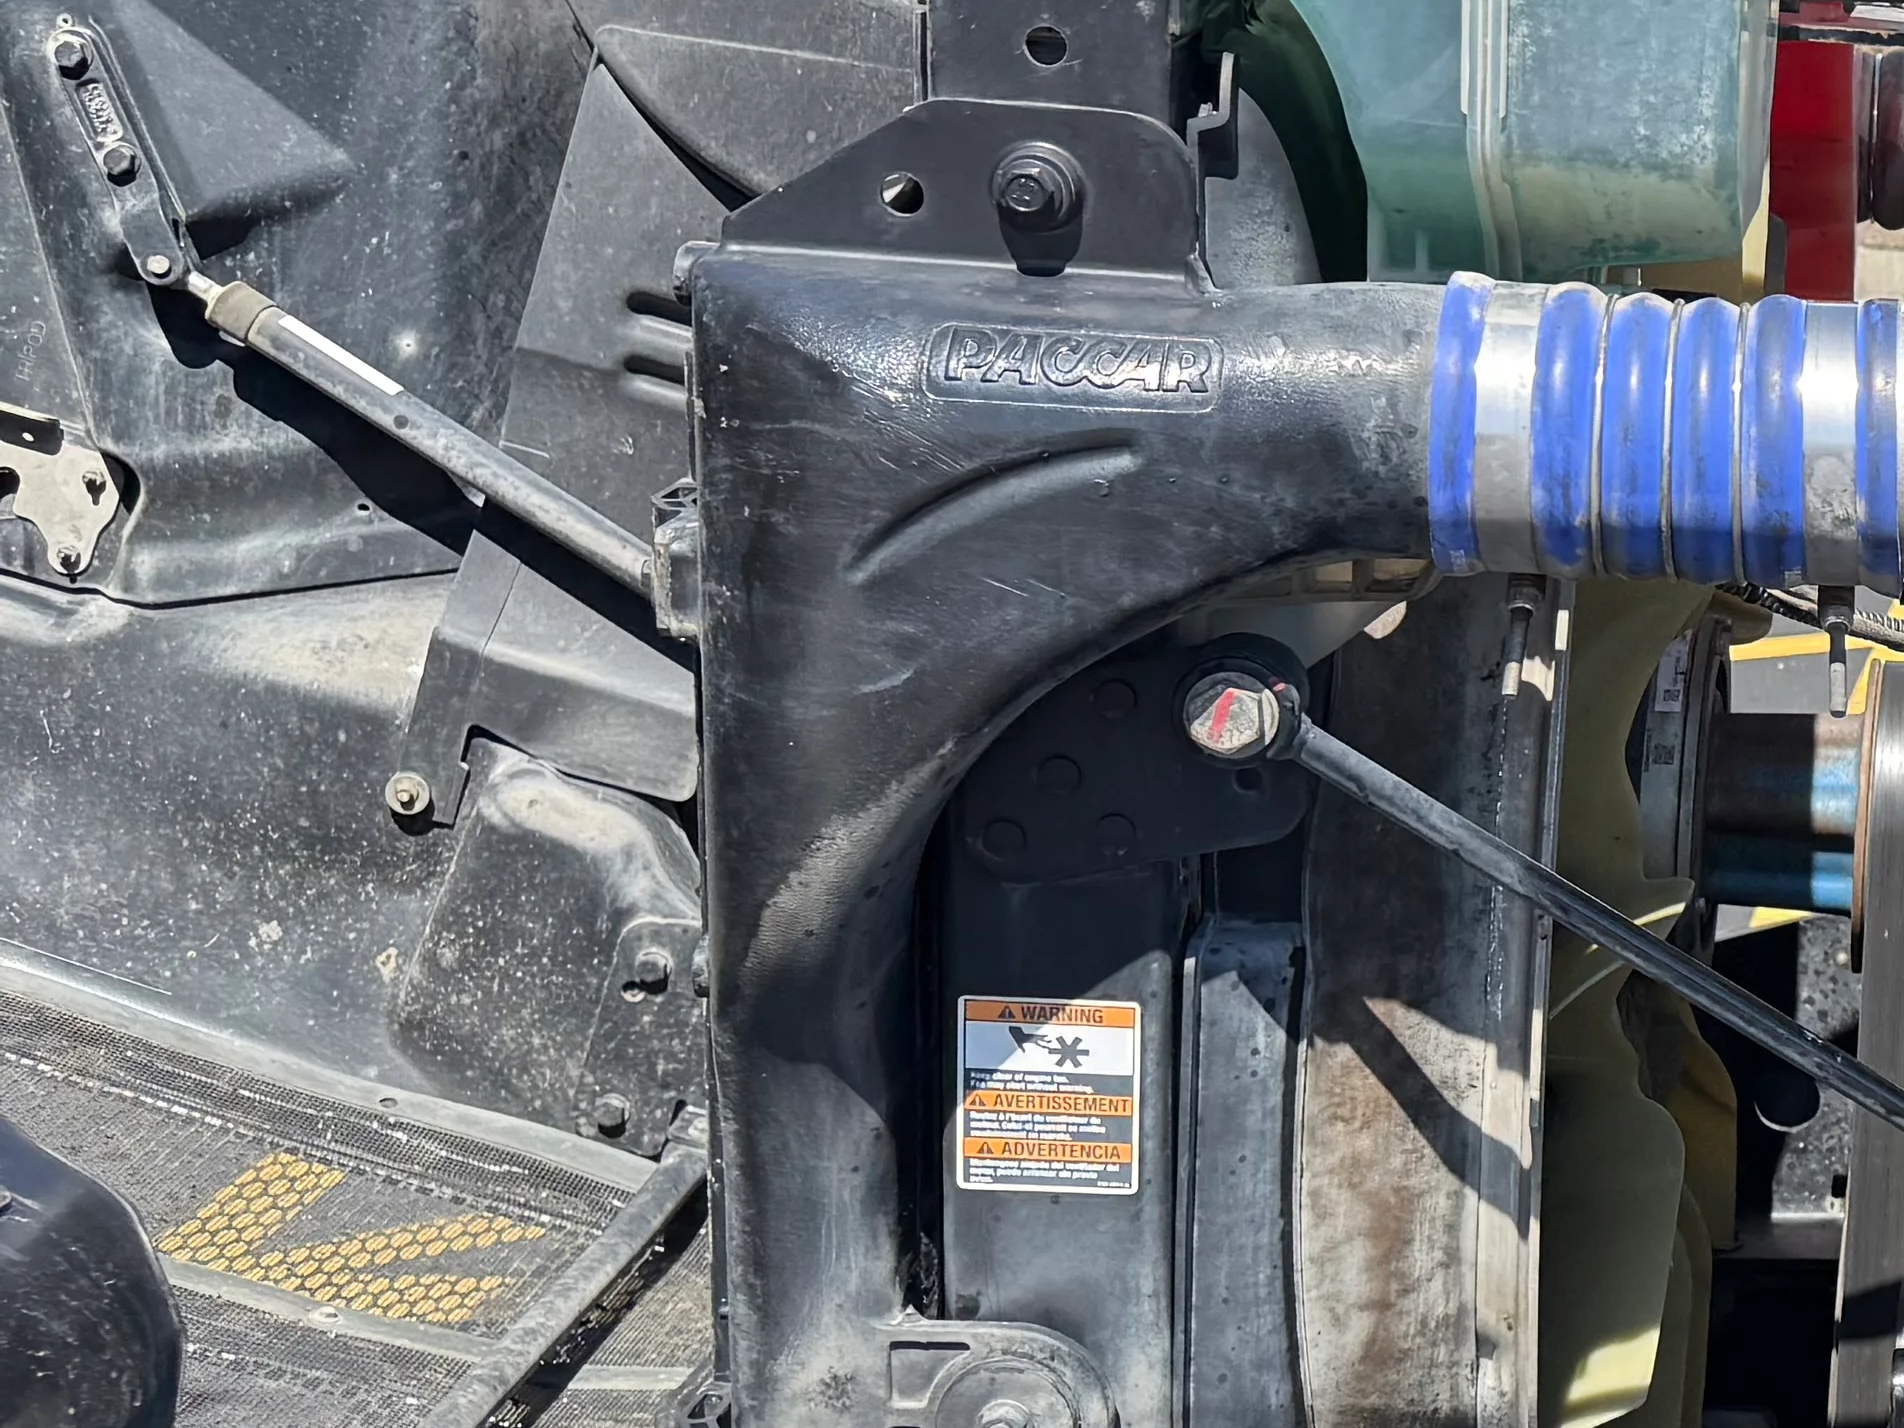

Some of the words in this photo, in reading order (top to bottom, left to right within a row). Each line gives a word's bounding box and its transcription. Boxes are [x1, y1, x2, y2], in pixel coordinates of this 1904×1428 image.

[942, 326, 1212, 393] PACCAR
[1020, 1005, 1104, 1024] WARNING
[993, 1093, 1130, 1113] AVERTISSEMENT
[1000, 1141, 1121, 1160] ADVERTENCIA
